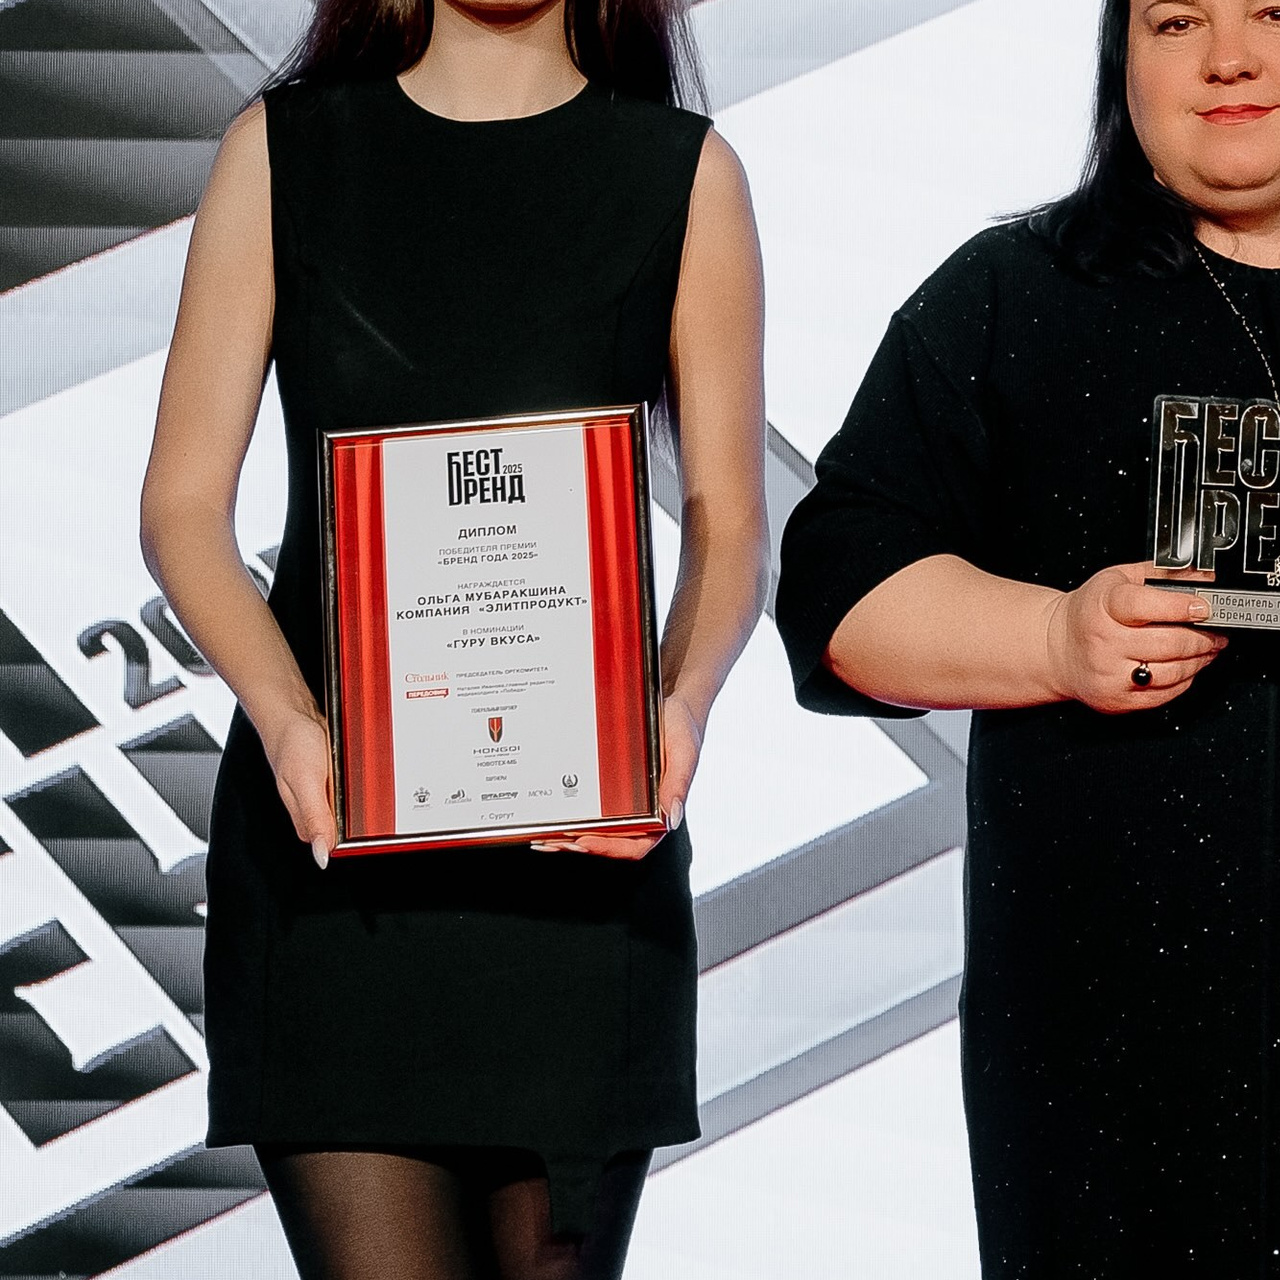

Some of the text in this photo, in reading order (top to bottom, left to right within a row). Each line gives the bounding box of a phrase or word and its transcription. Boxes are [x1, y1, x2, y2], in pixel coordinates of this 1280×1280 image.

[447, 448, 523, 477] БЕСТ 2025
[458, 525, 517, 540] ДИПЛОМ
[439, 541, 537, 556] ПОБЕДИТЕЛЯ ПРЕМИИ
[481, 553, 508, 563] ГОДА
[457, 578, 526, 589] НАГРАЖДАЕТСЯ
[417, 585, 567, 606] ОЛЬГА МУБАРАКШИНА
[1212, 594, 1274, 608] Победитель
[396, 596, 588, 620] КОМПАНИЯ «ЭЛИТПРОДУКТ»
[1212, 609, 1252, 621] «Бренд
[1255, 613, 1279, 623] года
[470, 624, 525, 635] НОМИНАЦИИ
[446, 634, 540, 649] «ГУРУ ВКУСА»
[473, 745, 520, 755] HONGQI
